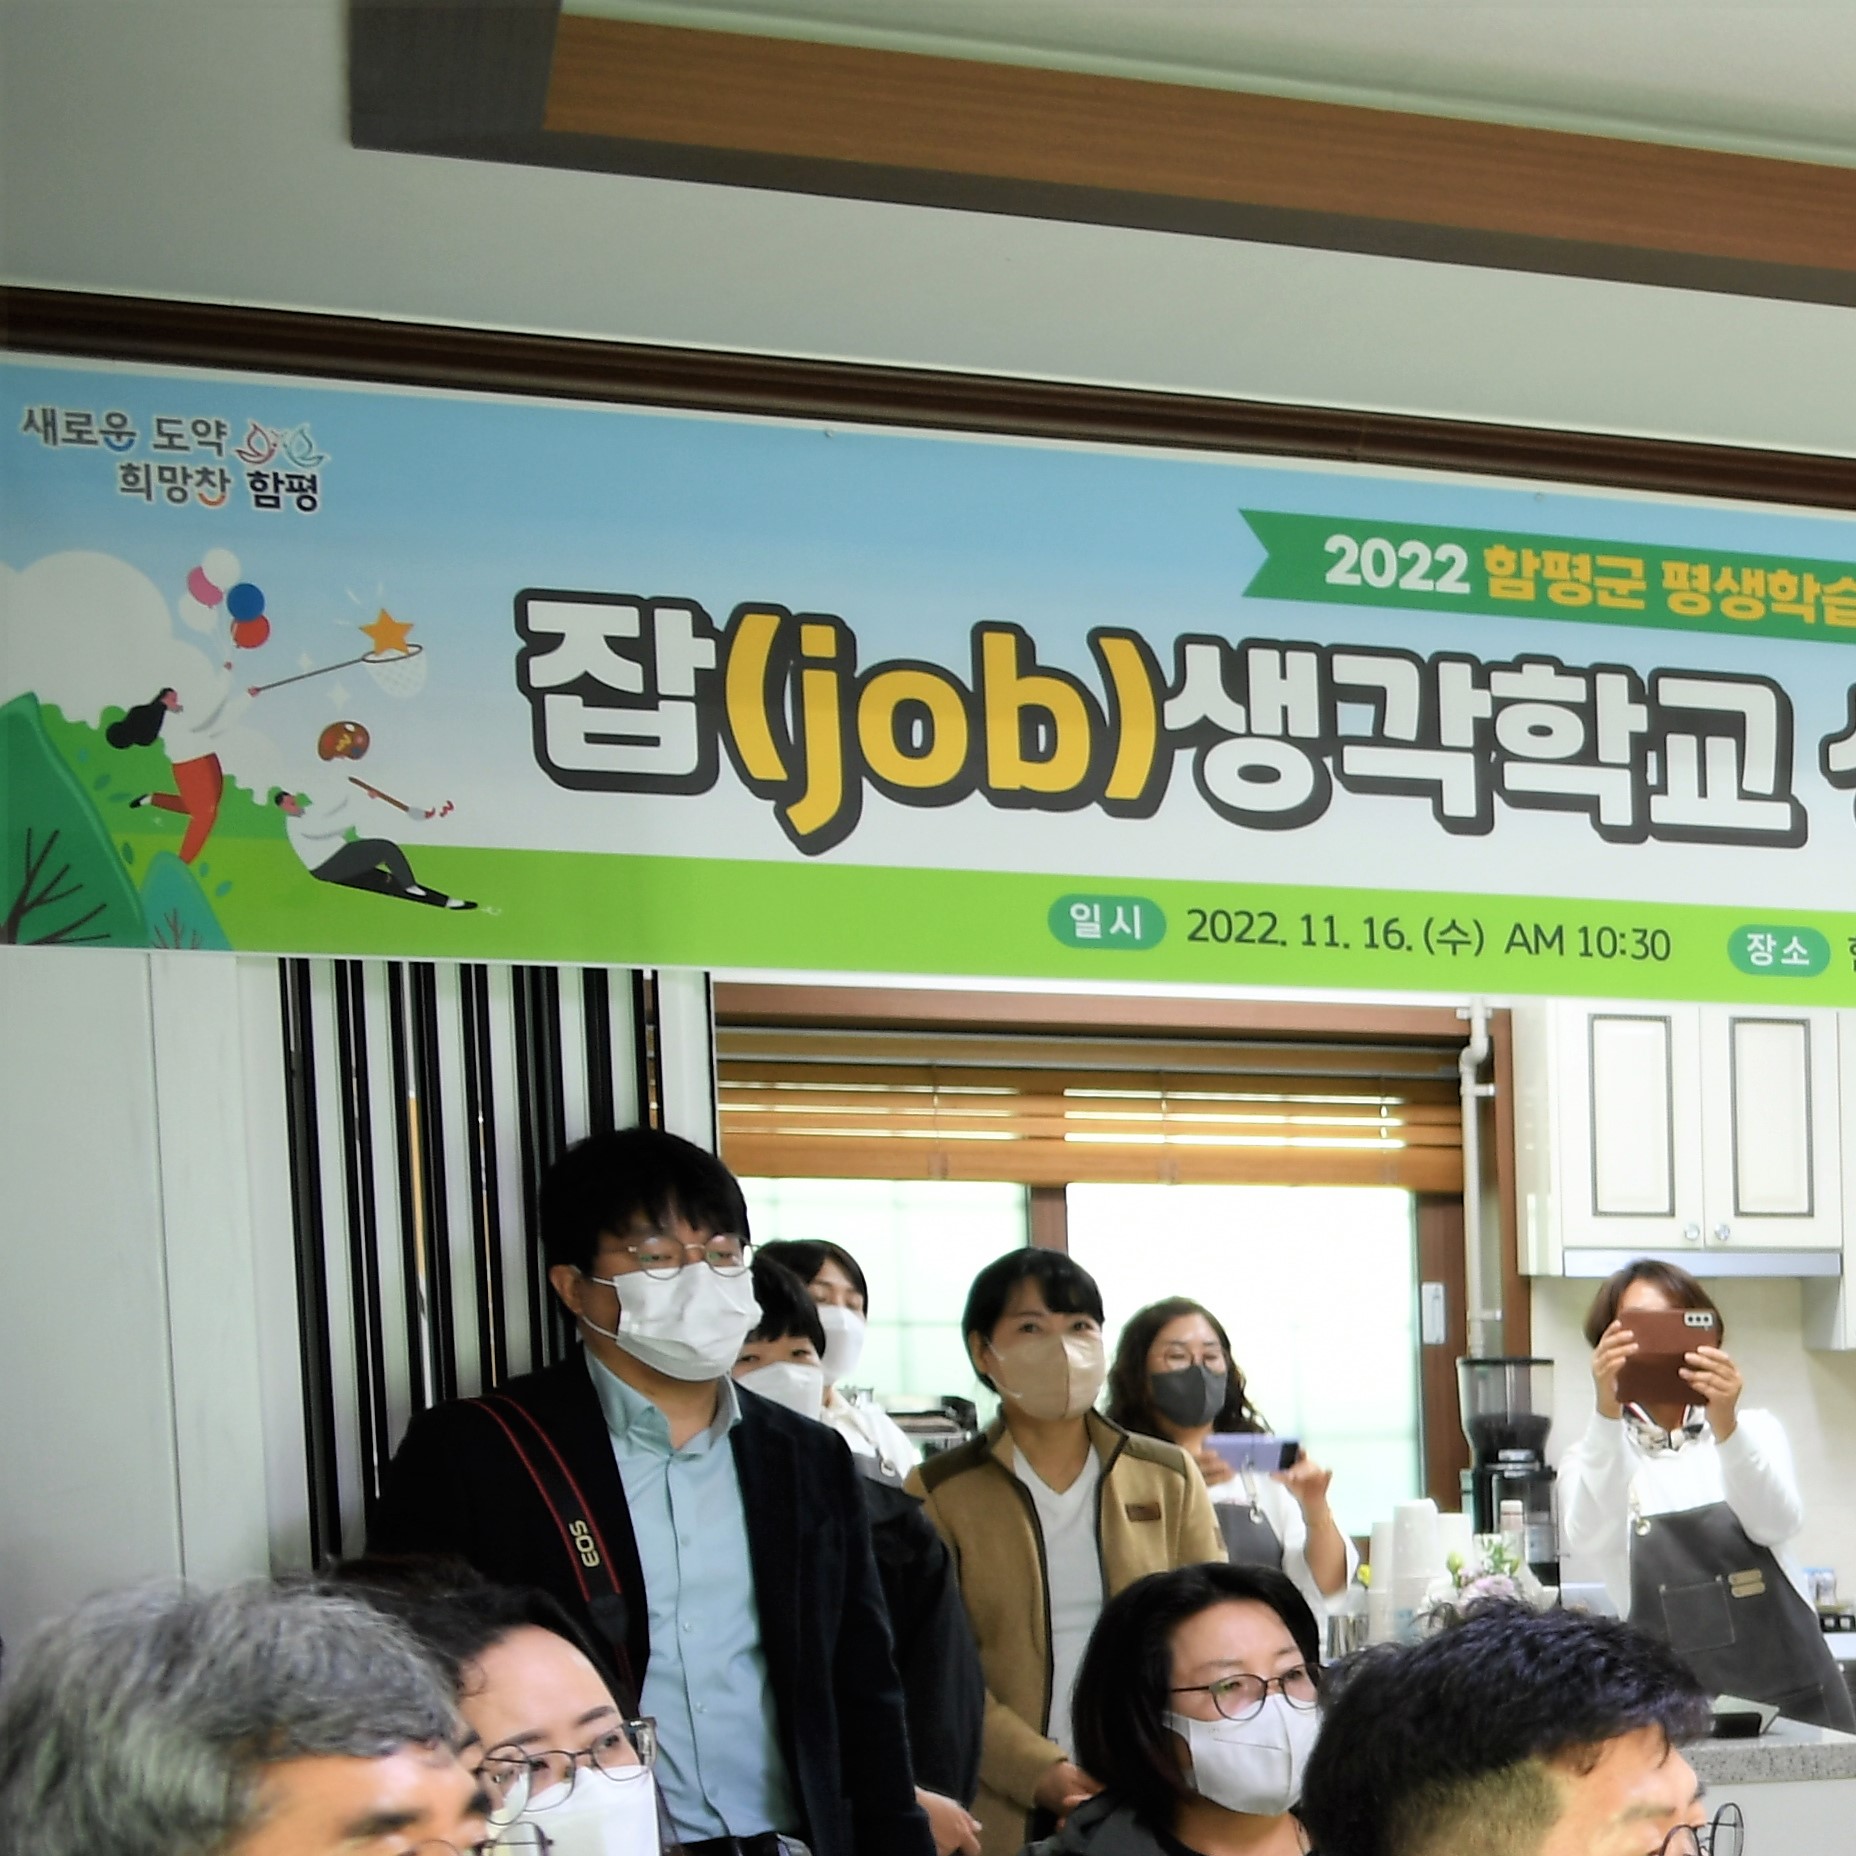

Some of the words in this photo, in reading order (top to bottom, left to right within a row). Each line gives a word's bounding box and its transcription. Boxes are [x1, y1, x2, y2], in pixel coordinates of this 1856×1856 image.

[22, 408, 137, 452] 새로운
[153, 417, 229, 457] 도약
[120, 463, 231, 507] 희망찬
[246, 470, 319, 513] 함평
[1324, 534, 1470, 594] 2022
[1484, 544, 1647, 609] 함평군
[515, 588, 1808, 855] 잡(job)생각학교
[1069, 902, 1142, 940] 일시
[1504, 923, 1564, 956] AM
[1578, 926, 1670, 961] 10:30
[1746, 933, 1810, 966] 장소
[568, 1519, 601, 1568] EOS
